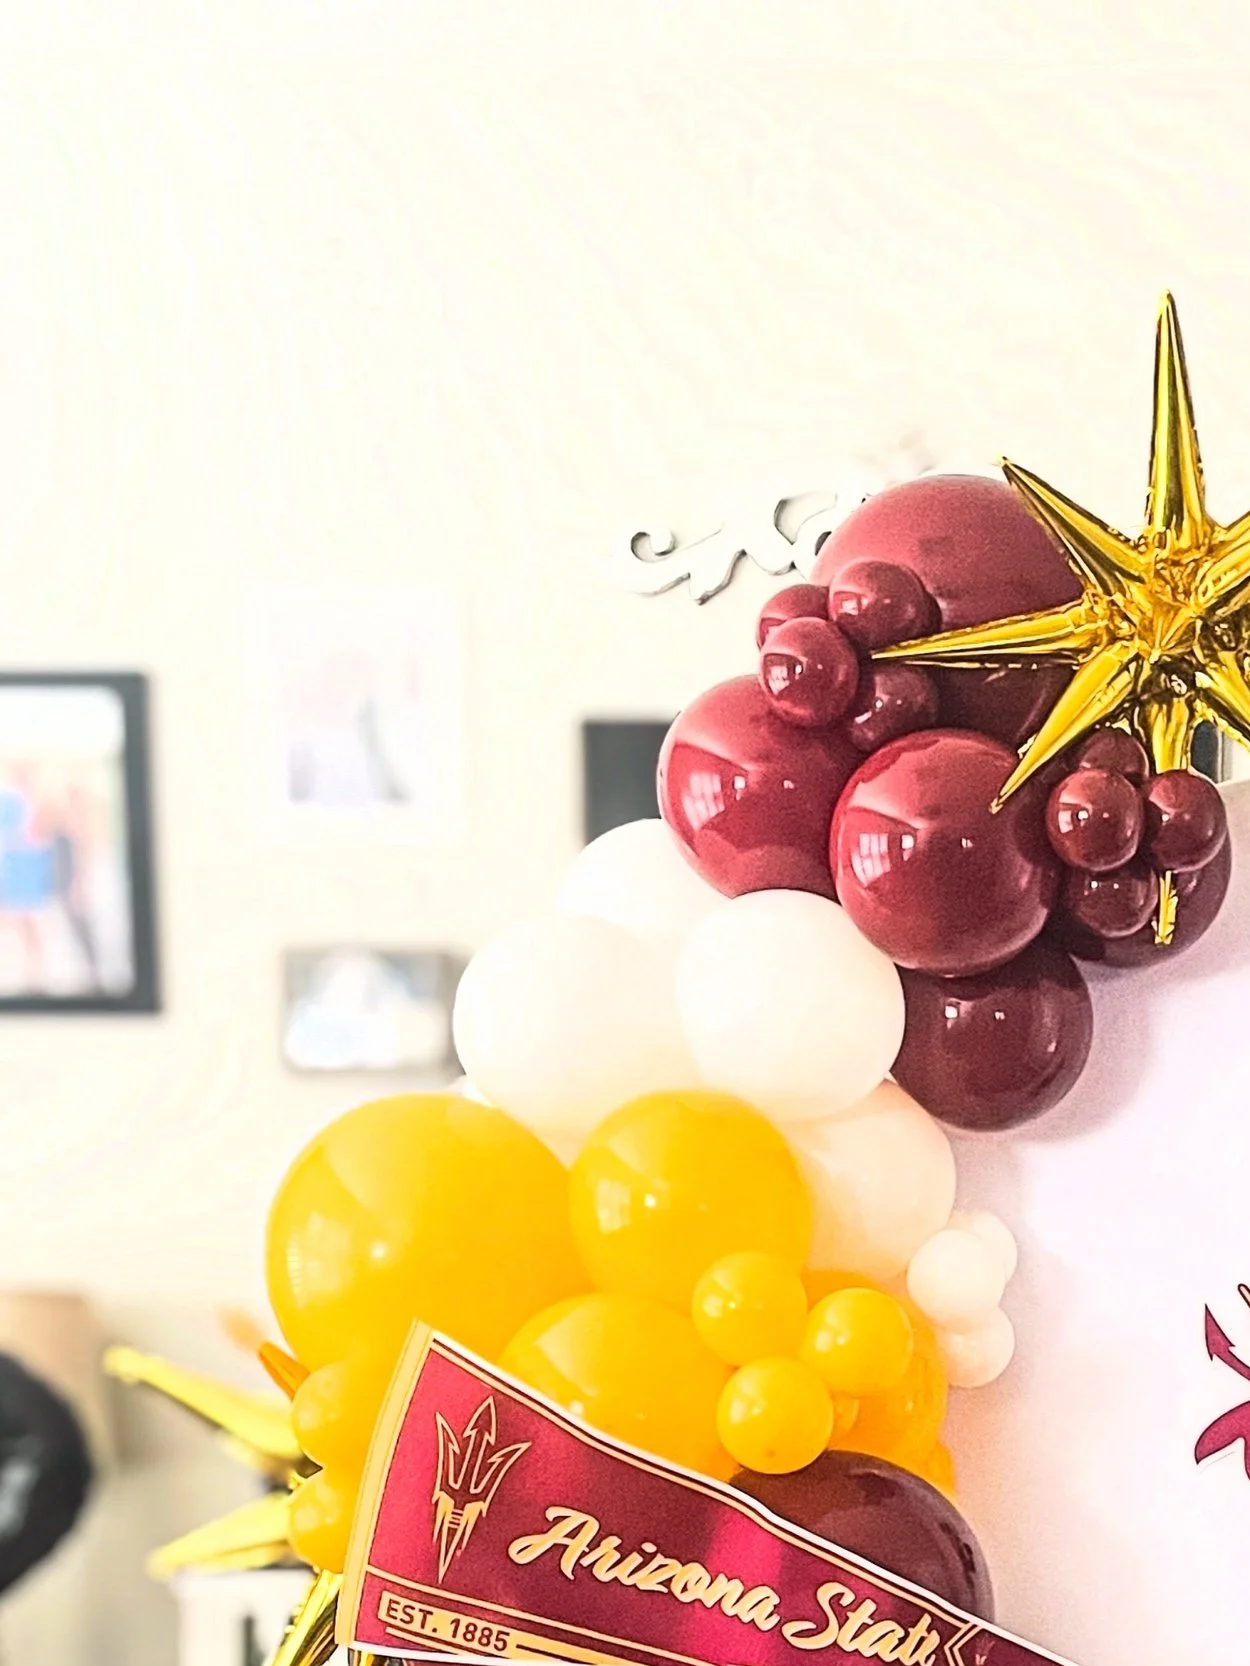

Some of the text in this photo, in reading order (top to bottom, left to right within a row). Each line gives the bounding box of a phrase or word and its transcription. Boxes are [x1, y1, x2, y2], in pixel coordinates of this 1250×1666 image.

[508, 1506, 781, 1631] Arizona
[386, 1598, 510, 1652] EST. 1885
